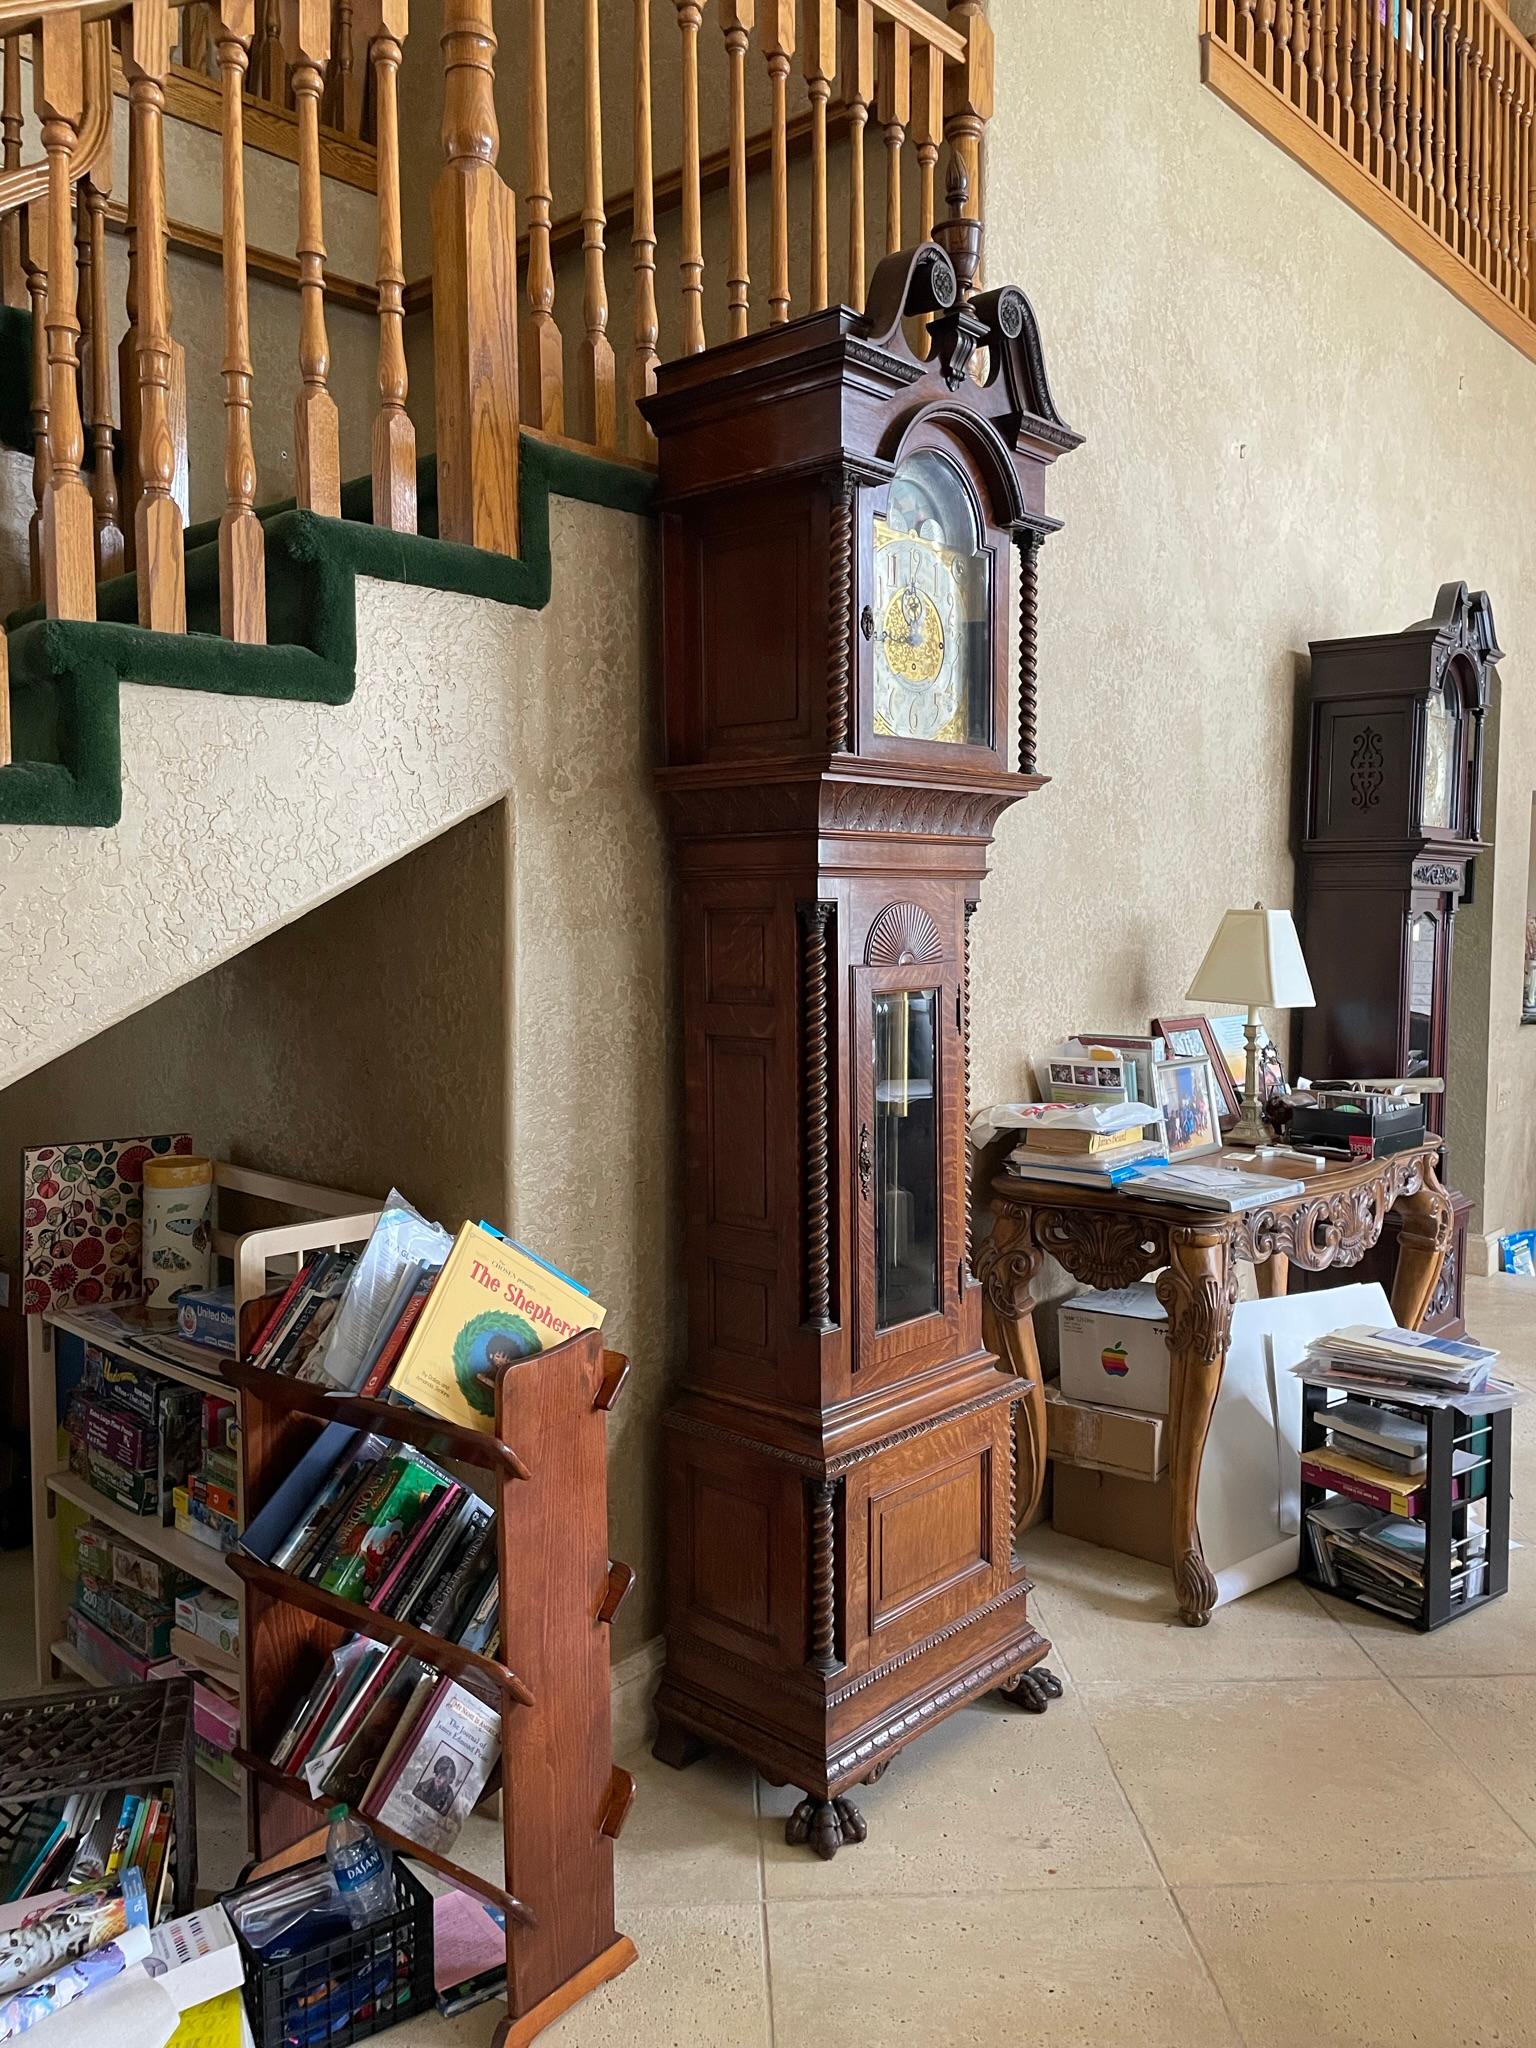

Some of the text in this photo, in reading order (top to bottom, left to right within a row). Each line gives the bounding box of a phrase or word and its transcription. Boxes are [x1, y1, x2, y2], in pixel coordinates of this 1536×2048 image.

[197, 1304, 220, 1322] United
[469, 1260, 582, 1338] The Shepherd
[346, 1852, 381, 1880] DASANI
